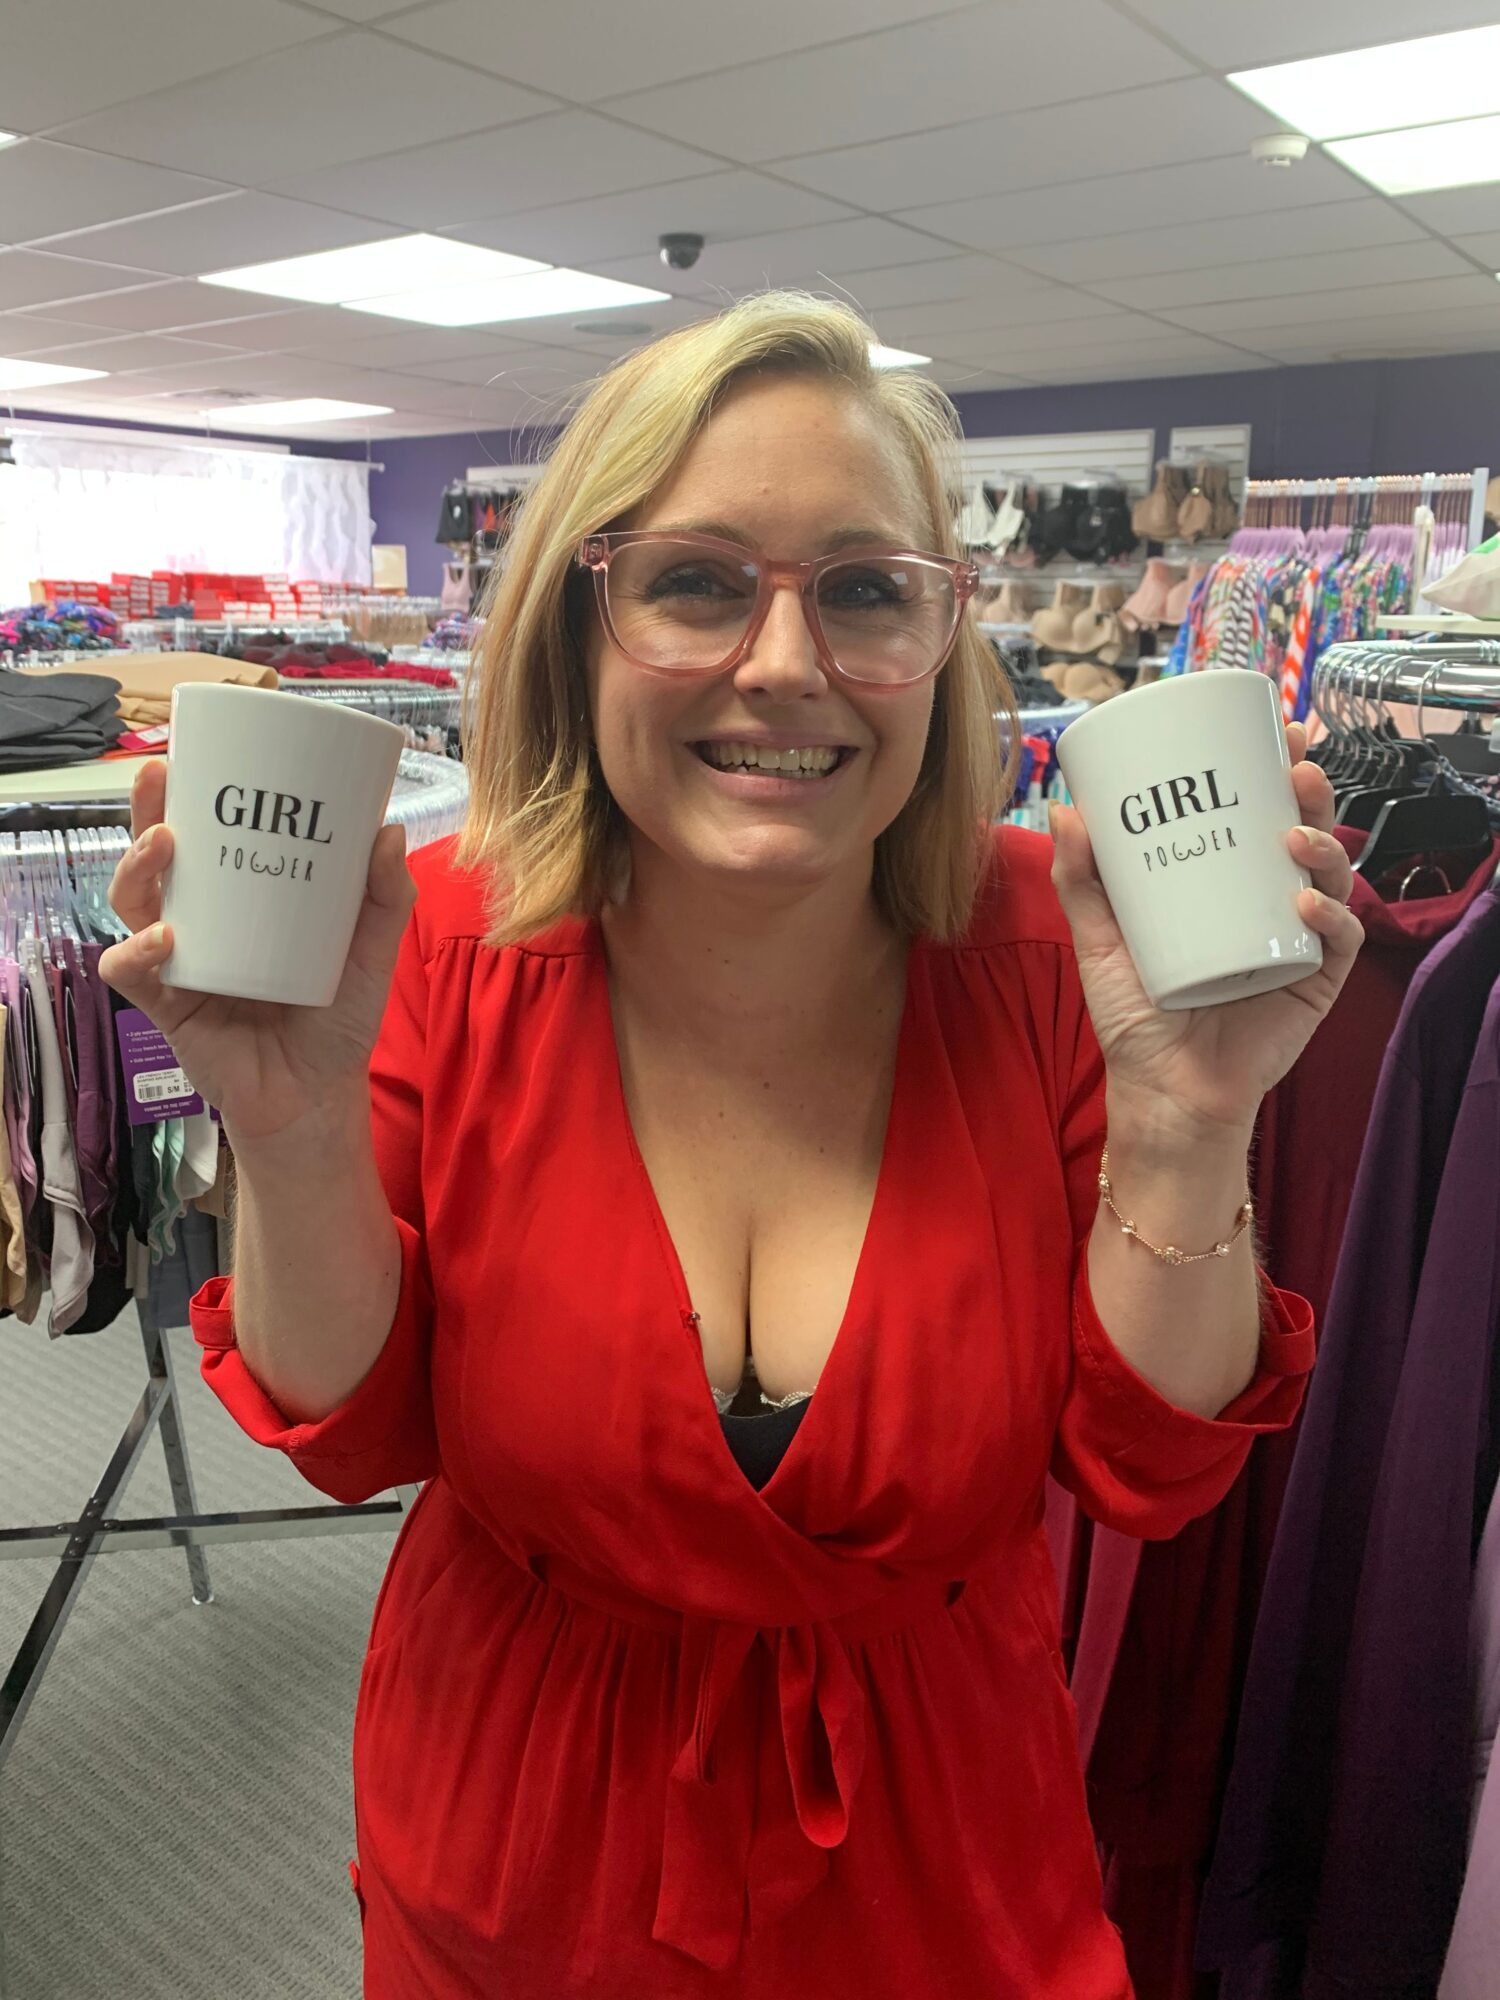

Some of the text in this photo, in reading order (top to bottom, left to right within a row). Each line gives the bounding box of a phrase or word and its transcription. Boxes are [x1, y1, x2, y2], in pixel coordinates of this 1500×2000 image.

[214, 784, 333, 844] GIRL
[1120, 769, 1239, 835] GIRL
[219, 845, 313, 882] POWER
[1143, 827, 1237, 872] POWER
[167, 1085, 180, 1094] S/M
